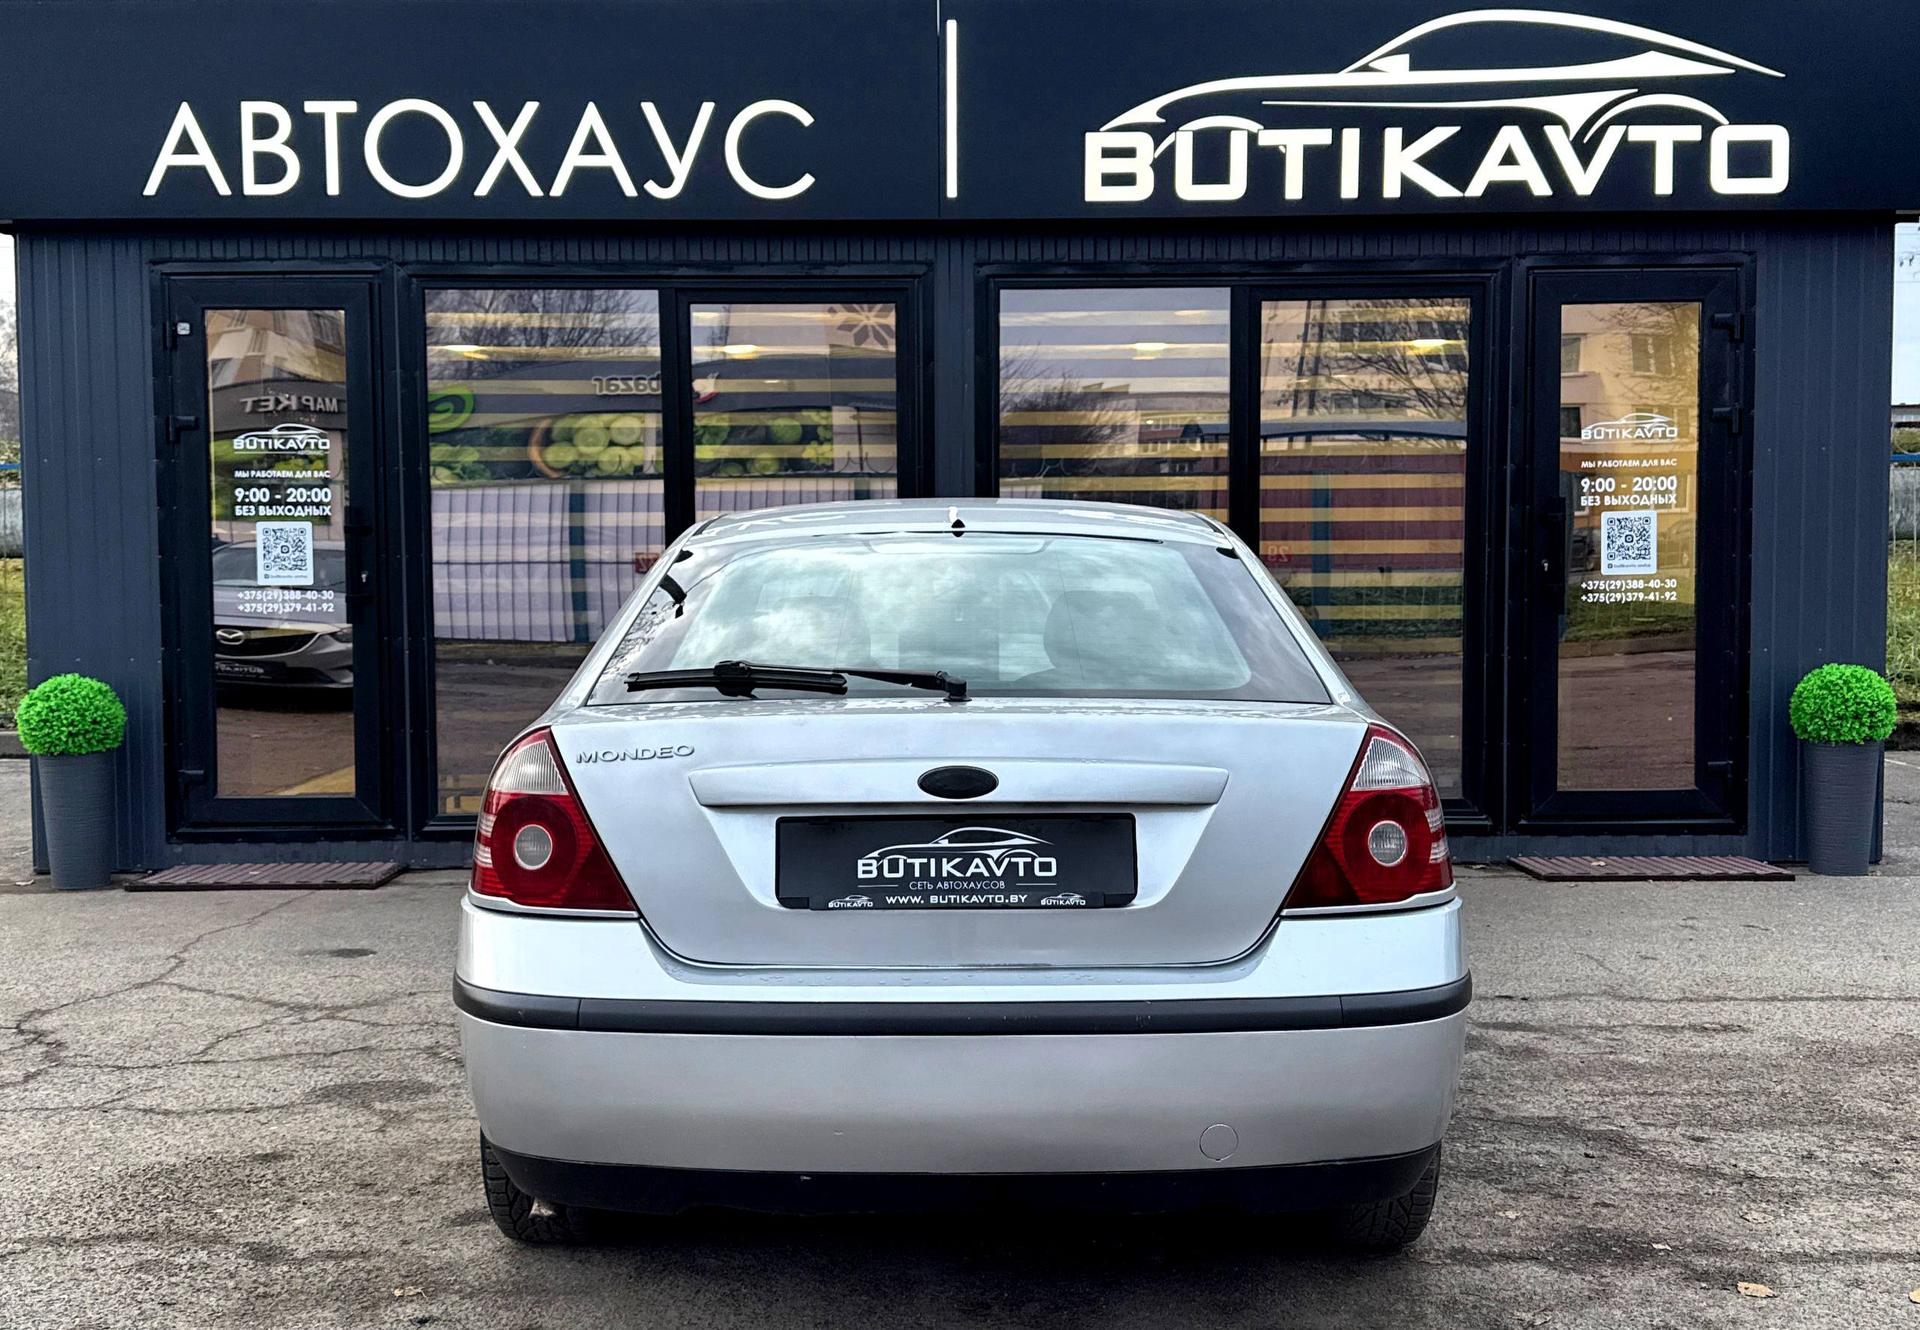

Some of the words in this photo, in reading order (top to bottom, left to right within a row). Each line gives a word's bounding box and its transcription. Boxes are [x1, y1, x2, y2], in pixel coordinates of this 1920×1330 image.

[142, 98, 816, 200] АВТОХАУС
[1084, 123, 1790, 202] BUTIKAVTO
[1581, 427, 1678, 440] BUTIKAVTO
[233, 438, 331, 450] BUTIKAVTO
[1597, 460, 1639, 468] РАБОТАЕМ
[1641, 459, 1658, 467] ДЛЯ
[1660, 458, 1677, 466] ВАС
[234, 470, 249, 478] МЫ
[251, 470, 294, 478] РАБОТАЕМ
[295, 470, 311, 478] ДЛЯ
[313, 470, 331, 478] ВАС
[1581, 477, 1616, 493] 9:00
[1632, 475, 1678, 491] 20:00
[234, 487, 270, 503] 9:00
[286, 487, 332, 503] 20:00
[1580, 496, 1600, 507] БЕЗ
[1604, 494, 1677, 506] ВЫХОДНЫХ
[235, 505, 256, 516] БЕЗ
[258, 505, 332, 517] ВЫХОДНЫХ
[1580, 579, 1678, 592] +375(29)388-40-30
[1580, 591, 1678, 605] +375(29)379-41-92
[237, 603, 335, 615] +375(29)379-41-92
[576, 745, 695, 764] MONDEO
[857, 857, 1058, 879] BUTIKAVTO
[909, 880, 934, 891] СЕТЬ
[936, 879, 1006, 890] АВТОХАУСОВ
[929, 894, 1028, 904] BUTIKAVTO.BY
